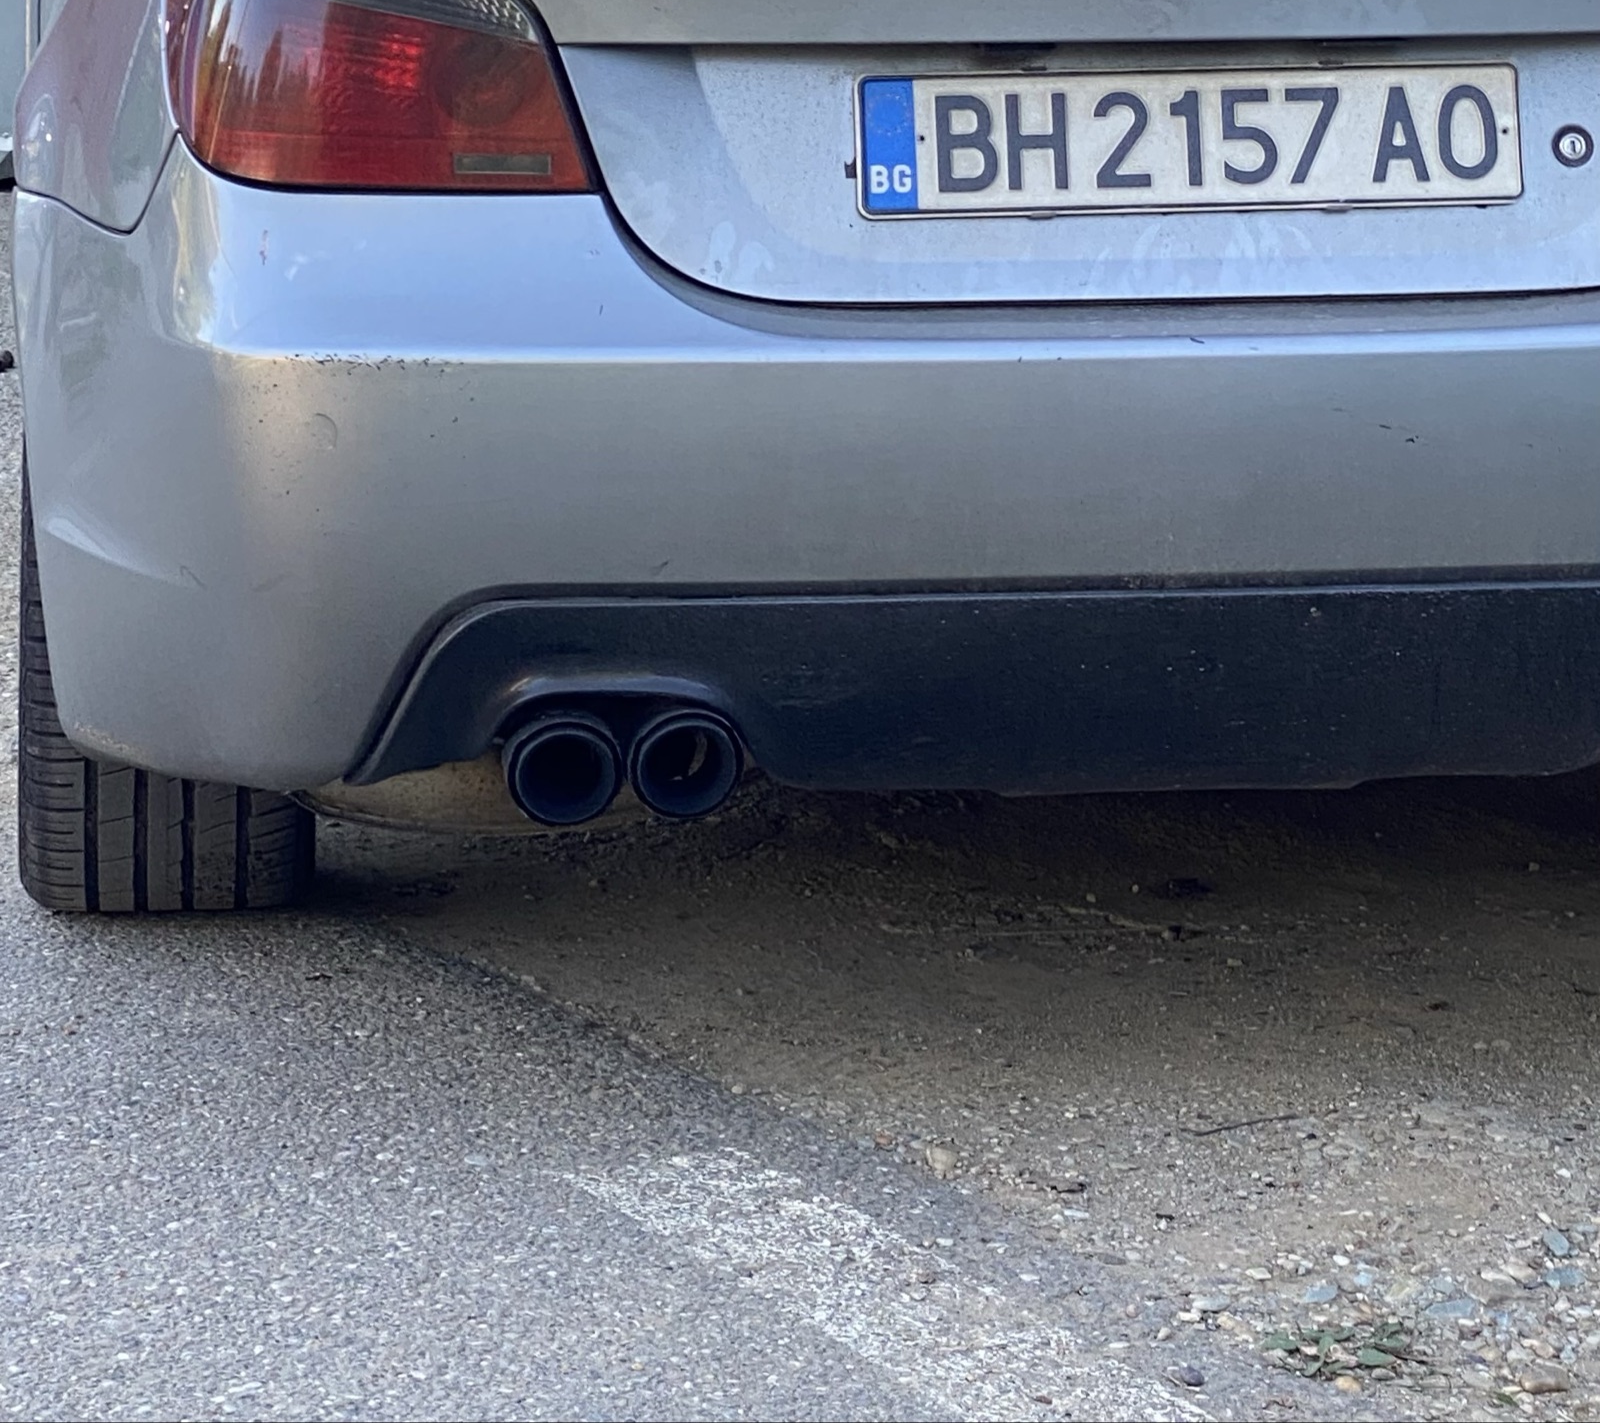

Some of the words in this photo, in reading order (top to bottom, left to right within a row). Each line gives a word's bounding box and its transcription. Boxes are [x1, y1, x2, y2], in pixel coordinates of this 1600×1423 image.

[935, 92, 1069, 193] BH
[1093, 86, 1340, 188] 2157
[1372, 84, 1499, 183] AO
[870, 164, 913, 194] BG
